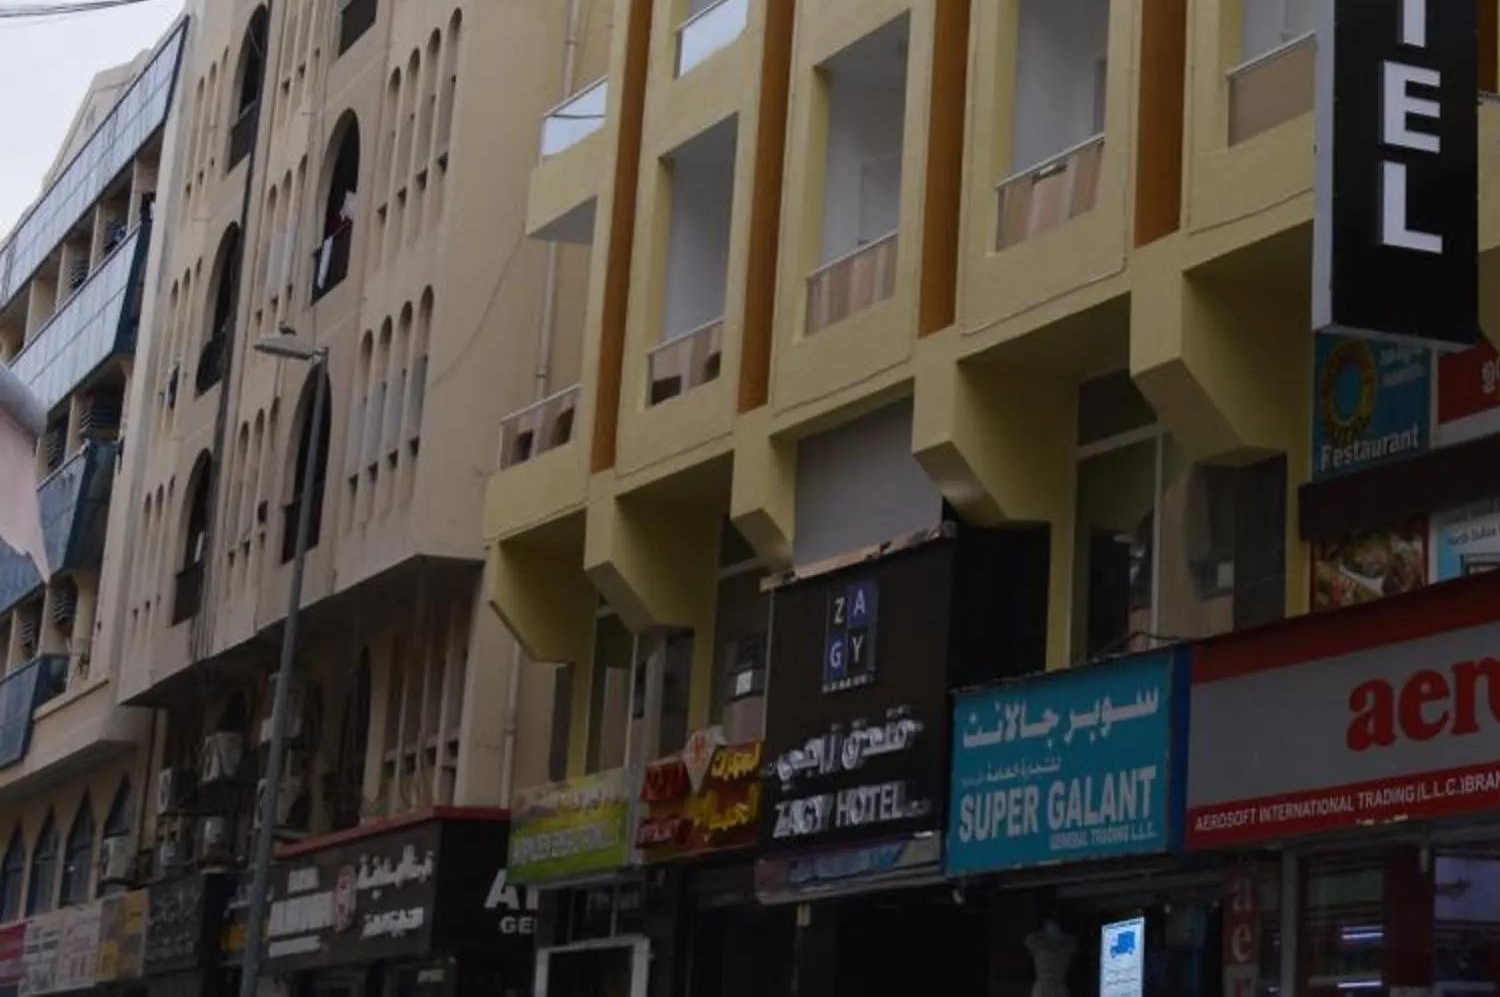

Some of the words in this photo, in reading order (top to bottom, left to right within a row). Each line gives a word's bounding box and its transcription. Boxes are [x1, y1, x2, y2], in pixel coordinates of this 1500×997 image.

[1320, 424, 1419, 472] Restaurant
[962, 698, 1060, 749] جالانت
[1063, 686, 1159, 744] سوبر
[772, 793, 835, 839] ZAGY
[835, 780, 908, 828] HOTEL
[958, 784, 1040, 843] SUPER
[1047, 764, 1157, 831] GALANT
[1194, 809, 1257, 832] AEROSOFT
[1258, 792, 1356, 824] INTERNATIONAL
[1356, 783, 1416, 811] TRADING
